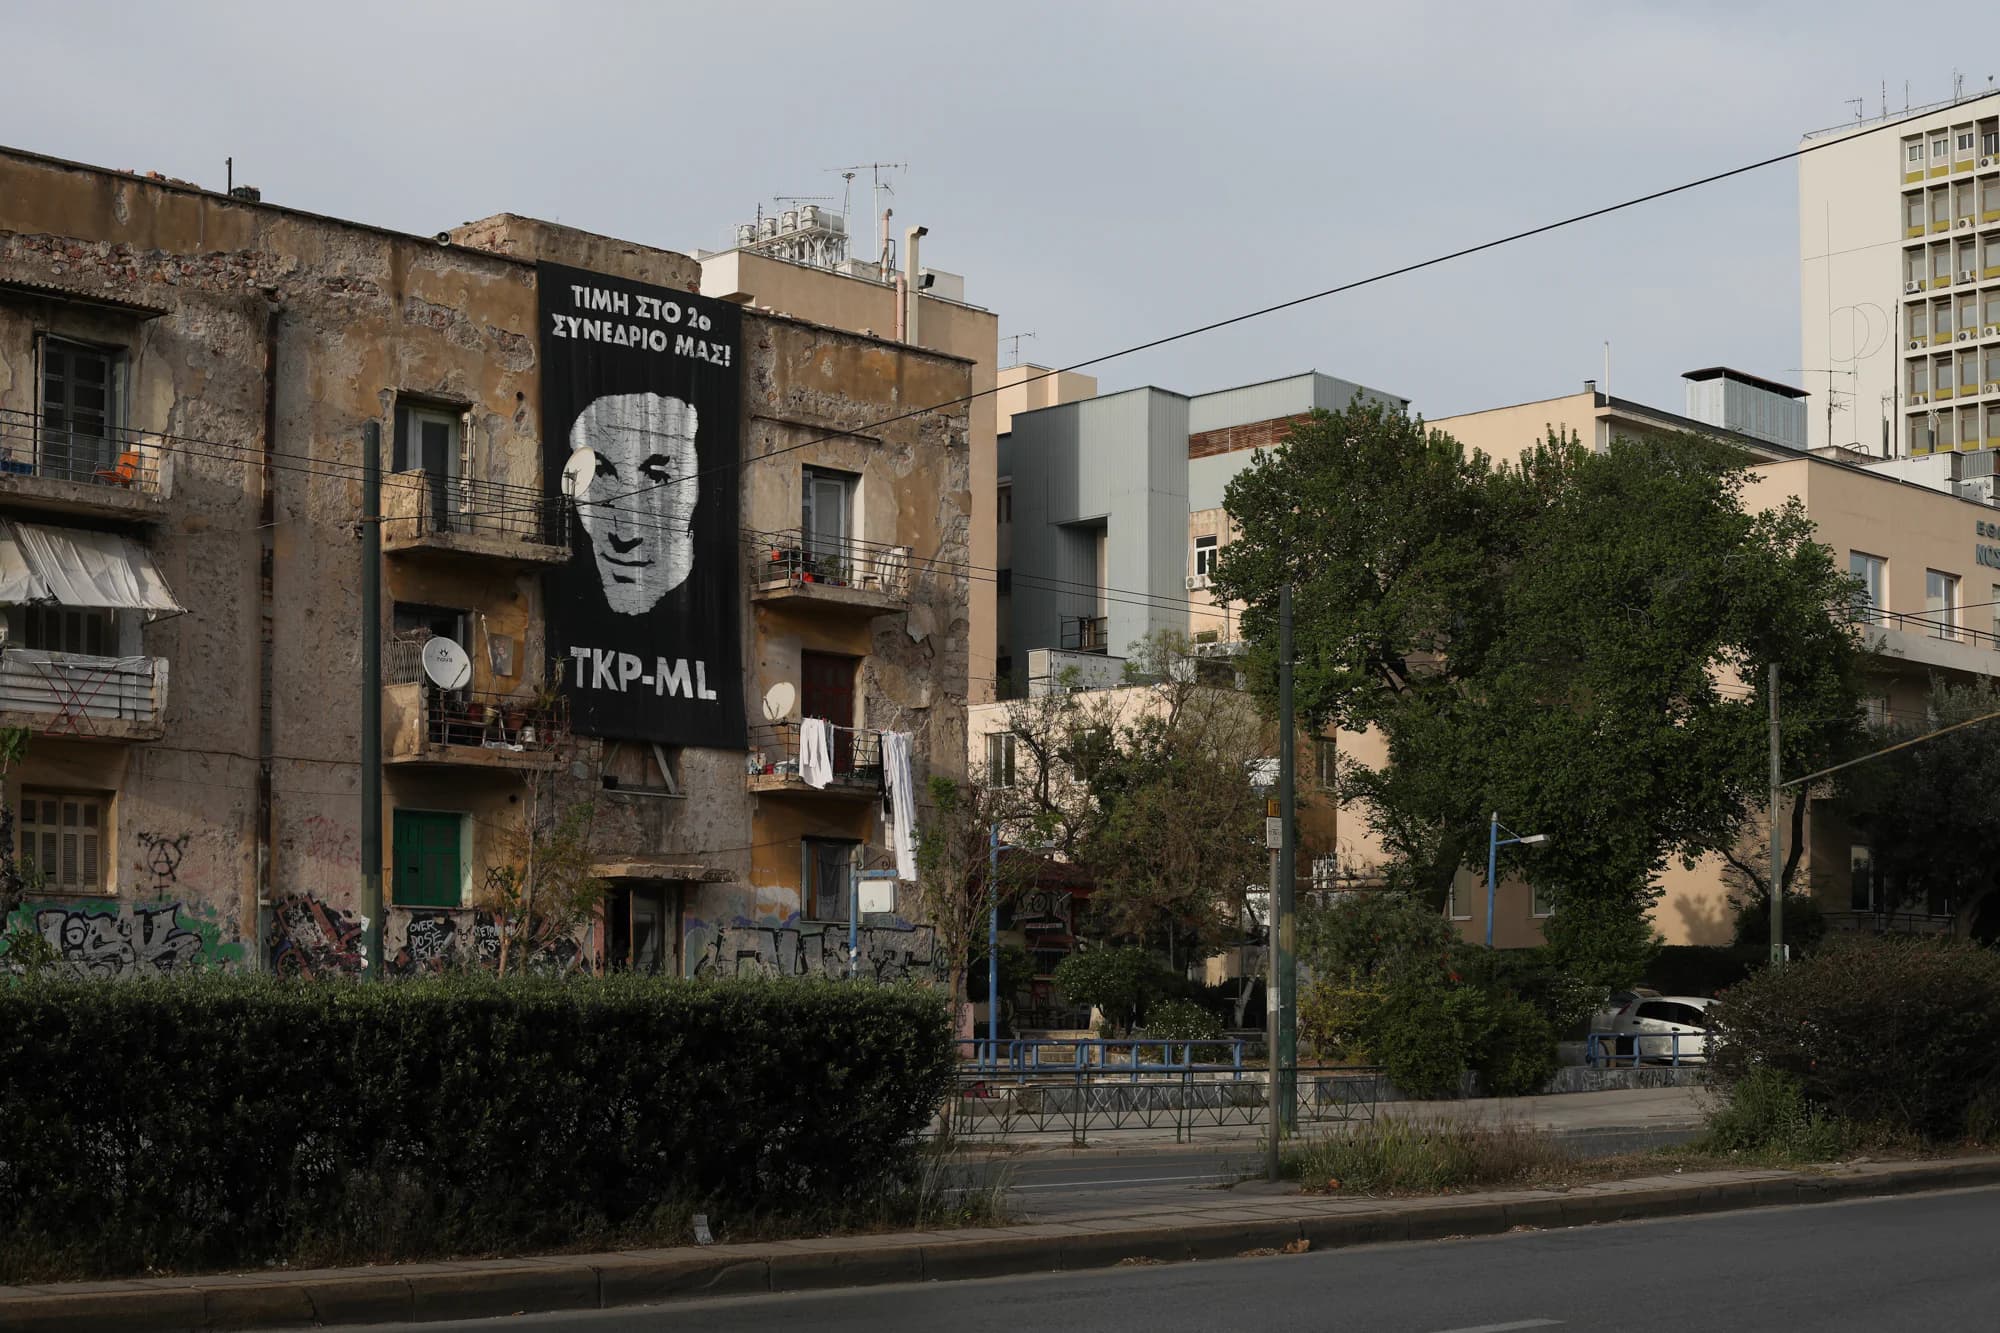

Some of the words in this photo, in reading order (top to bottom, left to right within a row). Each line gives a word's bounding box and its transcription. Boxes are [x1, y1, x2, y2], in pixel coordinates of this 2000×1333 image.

[571, 284, 630, 316] ΤΙΜΗ
[634, 295, 682, 324] ΣΤΟ
[551, 313, 668, 352] ΣΥΝΕΔΡΙΟ
[674, 334, 731, 367] ΜΑΣ!
[570, 646, 717, 701] TKP-ML
[409, 919, 438, 932] OVER
[410, 930, 442, 947] DOSE
